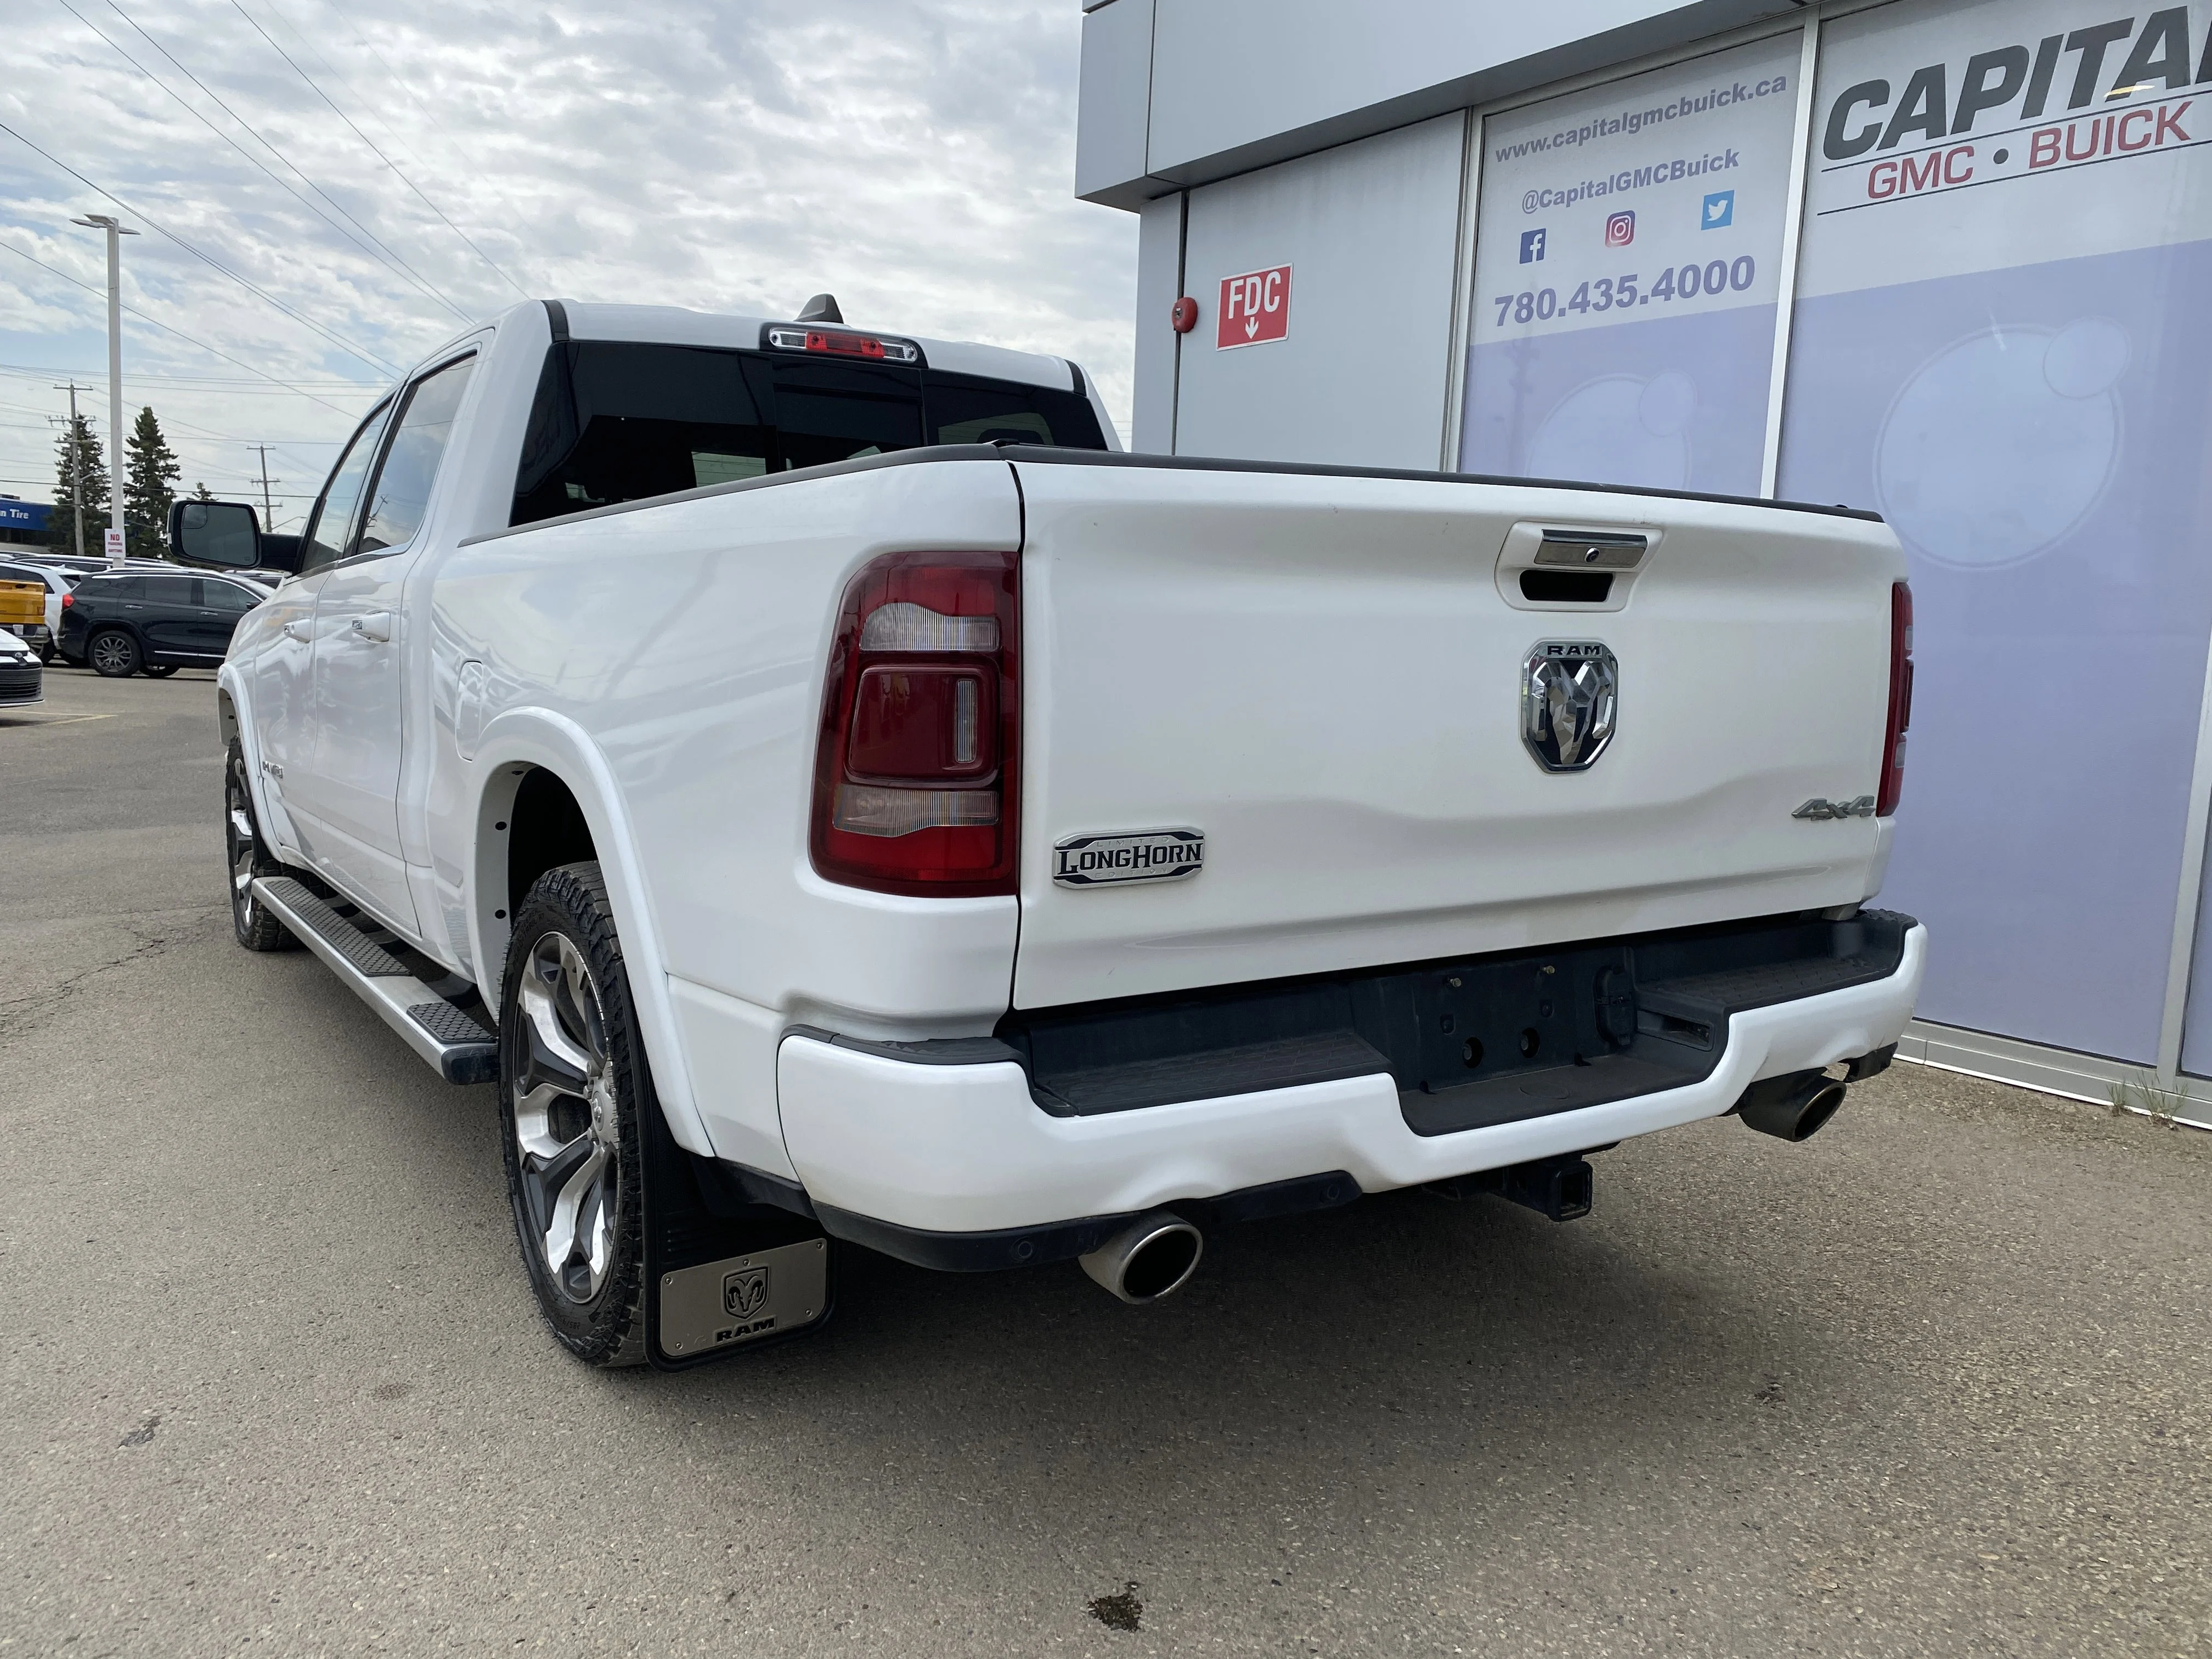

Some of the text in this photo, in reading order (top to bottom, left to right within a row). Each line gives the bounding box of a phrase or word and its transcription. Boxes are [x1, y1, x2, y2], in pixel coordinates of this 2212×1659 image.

[1823, 5, 2212, 161] CAPITA
[1495, 76, 1787, 162] www.capitalgmcbuick.ca
[1867, 101, 2193, 199] GMC BUICK
[1521, 148, 1740, 215] @CapitalGMCBuick
[1228, 271, 1281, 320] FDC
[1494, 255, 1756, 327] 780.435.4000
[9, 508, 29, 519] Tire
[1547, 645, 1600, 656] RAM
[1096, 836, 1170, 848] LIMITED
[1094, 867, 1169, 878] EDITION
[716, 1318, 775, 1342] RAM
